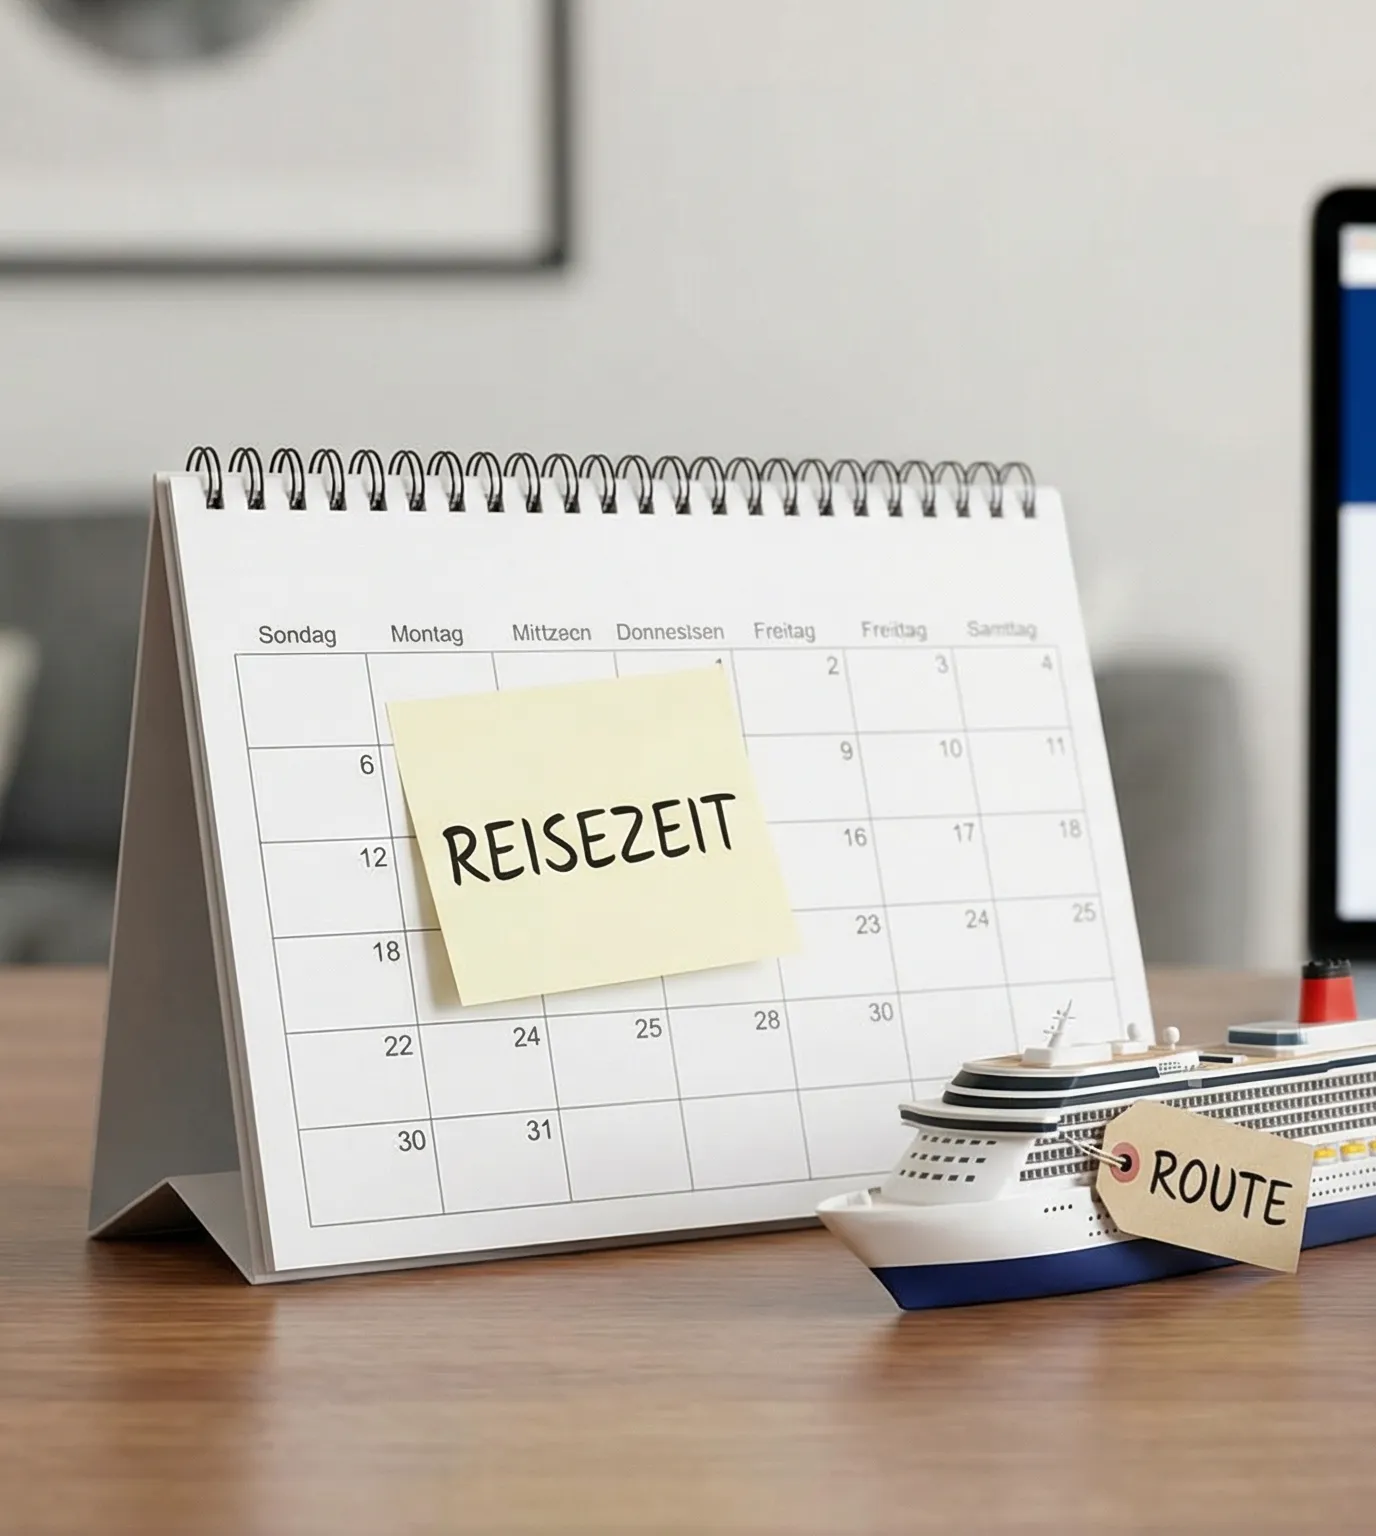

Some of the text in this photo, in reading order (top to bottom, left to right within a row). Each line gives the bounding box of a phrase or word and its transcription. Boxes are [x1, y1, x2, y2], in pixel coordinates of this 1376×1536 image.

[258, 625, 337, 648] Sondag
[390, 624, 464, 647] Montag
[753, 621, 816, 643] Freitag
[826, 654, 1054, 676] 2 3 4
[840, 736, 1066, 761] 9 10 11
[359, 754, 375, 775] 6
[442, 792, 737, 887] REISEZEIT
[844, 818, 1082, 847] 16 17 18
[359, 846, 388, 868] 12
[855, 902, 1097, 935] 23 24 25
[373, 940, 401, 963] 18
[384, 1001, 894, 1057] 22 24 25 28 30
[397, 1118, 552, 1152] 30 31
[1149, 1149, 1293, 1226] ROUTE
